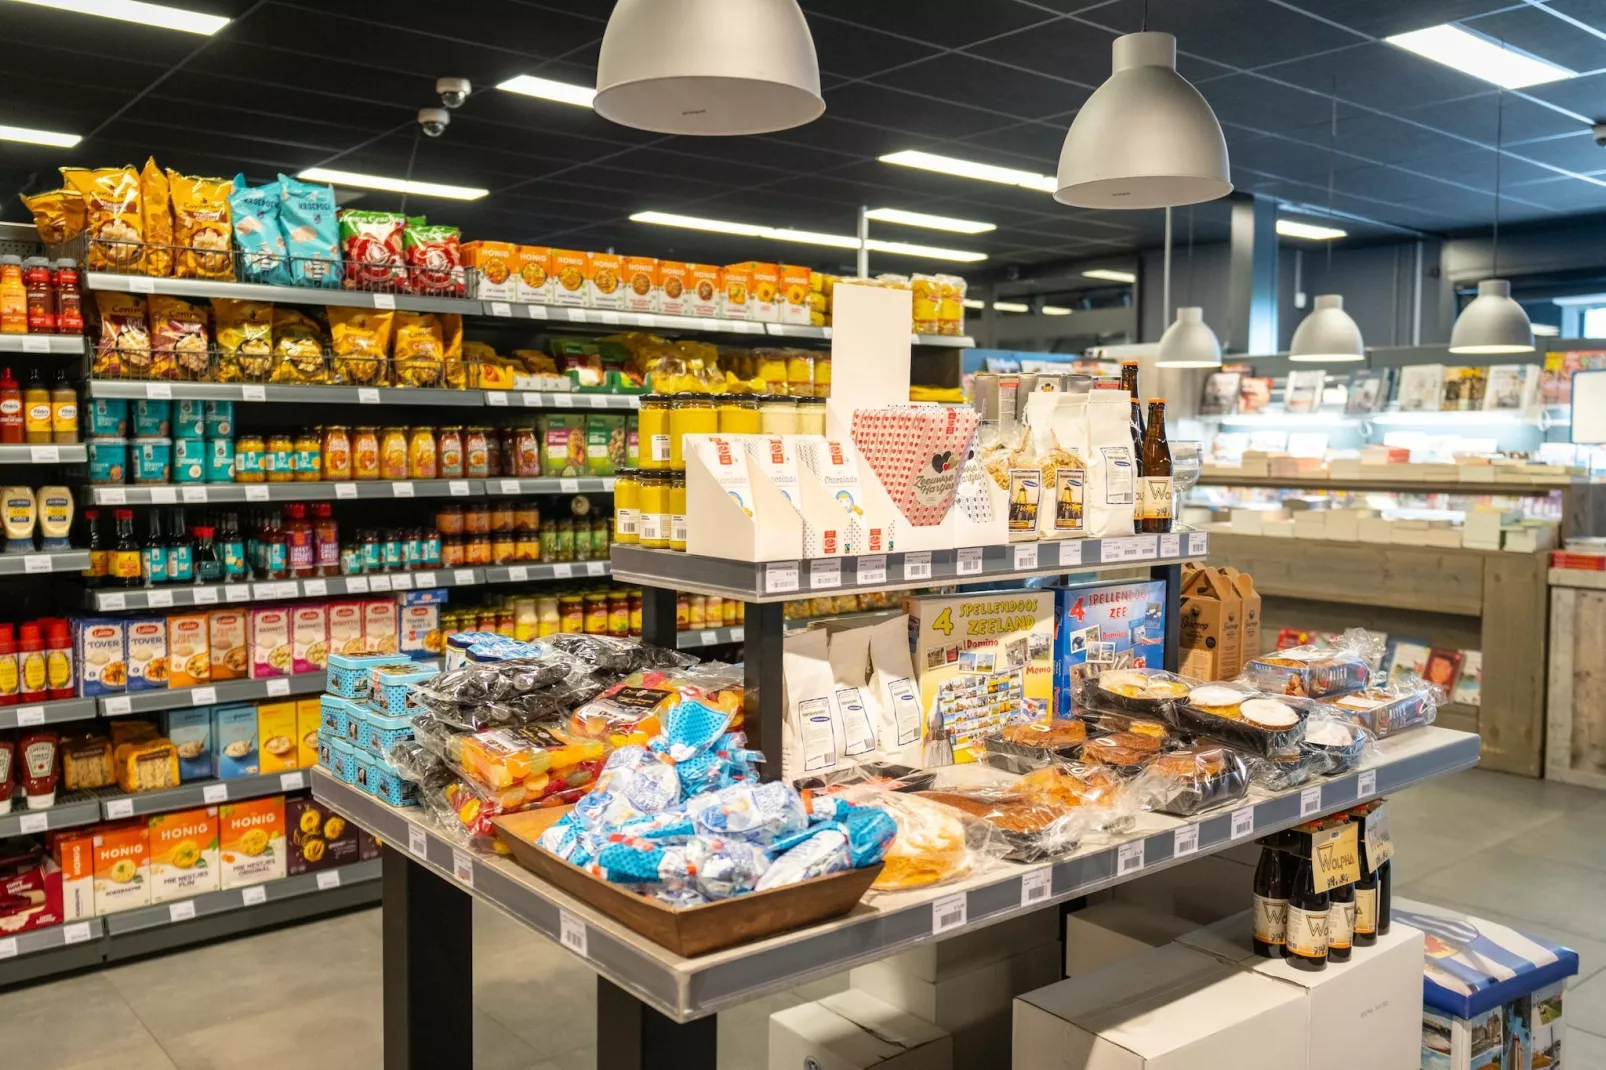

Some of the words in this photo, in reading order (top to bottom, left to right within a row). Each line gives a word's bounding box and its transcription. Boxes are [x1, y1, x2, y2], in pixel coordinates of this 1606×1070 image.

[244, 197, 279, 208] KROEPOEK
[482, 248, 509, 258] HONIG
[520, 253, 547, 262] HONIG
[557, 256, 583, 266] HONIG
[593, 260, 618, 269] HONIG
[629, 263, 654, 272] HONIG
[661, 267, 685, 276] HONIG
[693, 272, 717, 280] HONIG
[914, 474, 955, 490] Zeeuwse
[920, 482, 954, 496] Hartjes
[959, 599, 1038, 617] SPELLENDOOS
[1069, 595, 1086, 624] 4
[1109, 606, 1127, 619] ZEE
[932, 606, 954, 636] 4
[966, 615, 1037, 636] ZEELAND
[132, 637, 162, 646] TOVER
[1102, 631, 1127, 641] Domino
[90, 640, 119, 649] TOVER
[966, 638, 999, 650] Domino
[1026, 665, 1051, 676] Memo
[230, 812, 275, 830] HONIG
[161, 822, 208, 841] HONIG
[100, 843, 144, 861] HONIG
[73, 845, 81, 876] HONIG
[233, 862, 247, 872] MIE
[238, 866, 271, 878] ORIGINAL
[163, 877, 177, 886] MIE
[176, 871, 209, 884] NESTJES
[6, 880, 23, 890] curry
[8, 882, 33, 895] ketchup
[178, 880, 195, 889] FIJN
